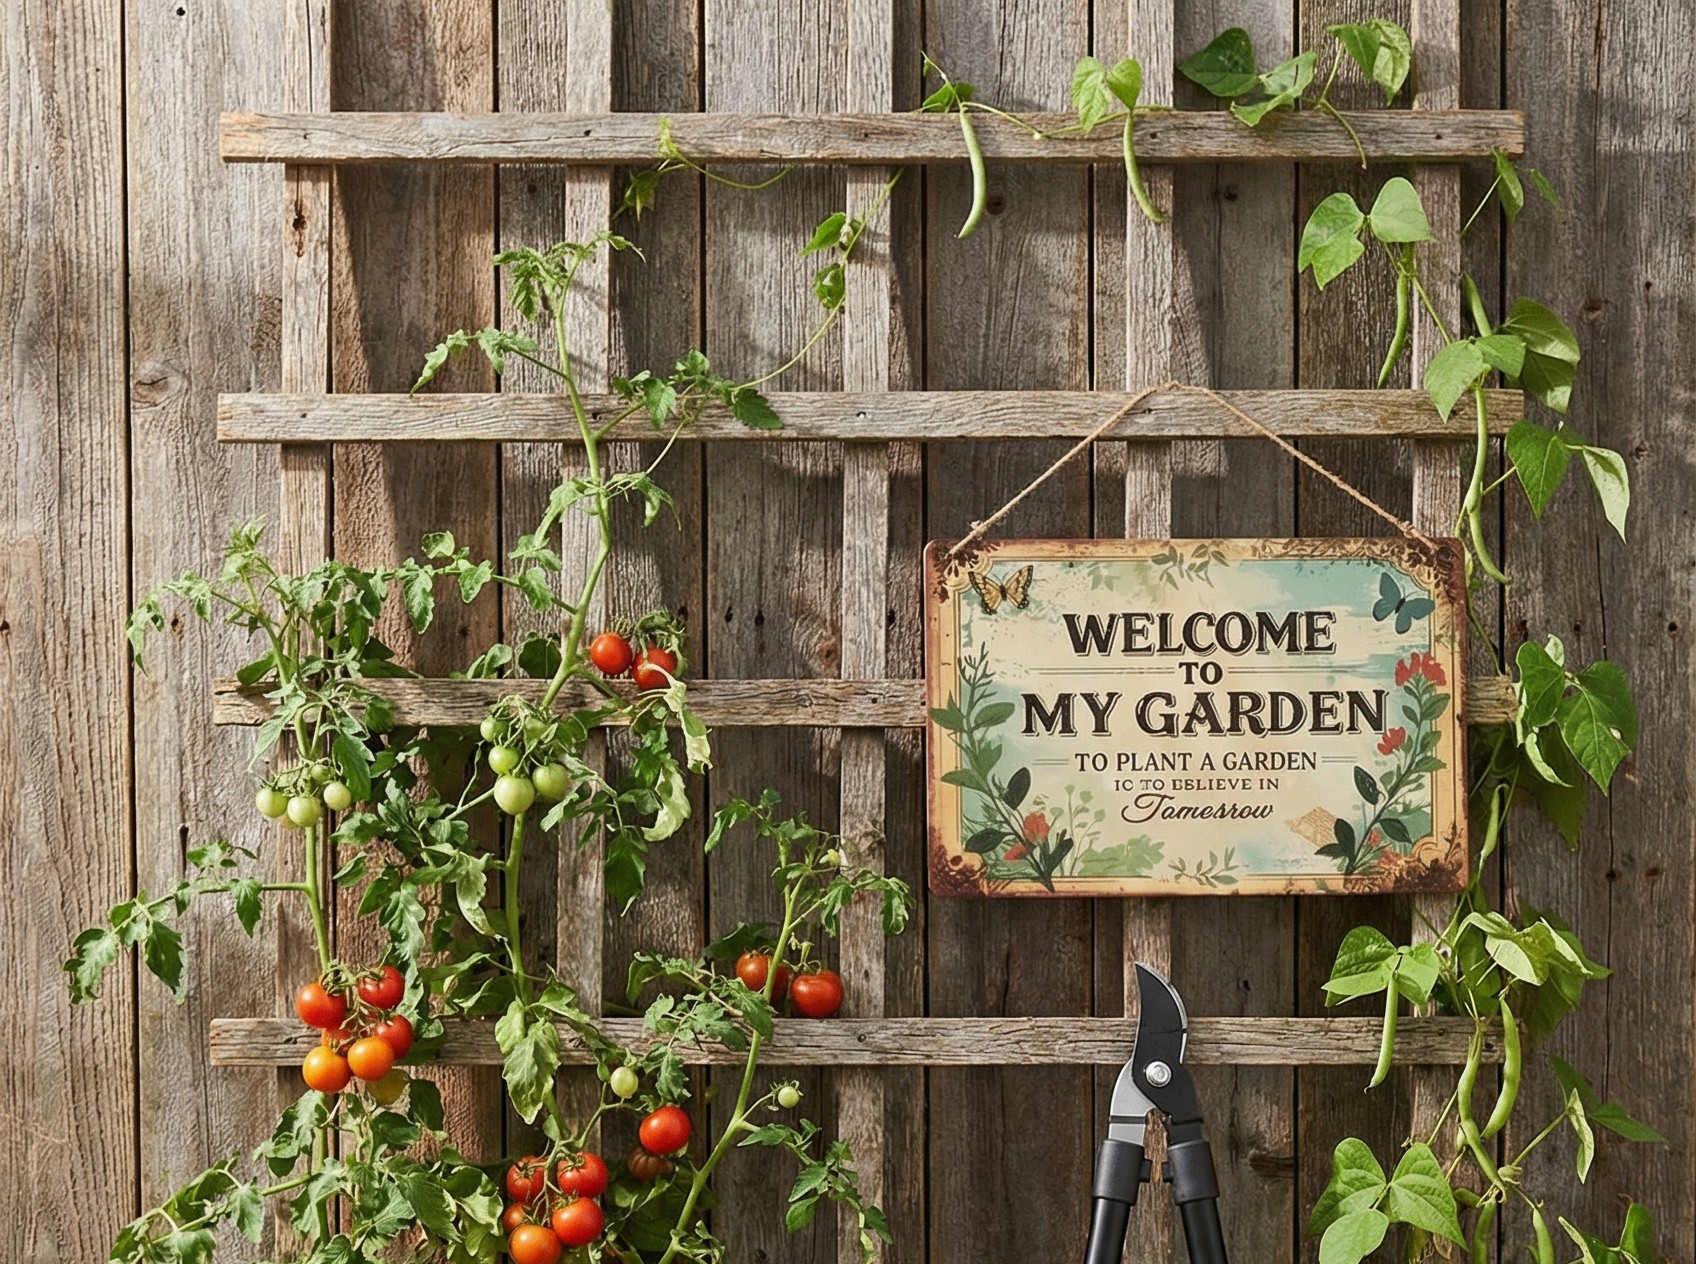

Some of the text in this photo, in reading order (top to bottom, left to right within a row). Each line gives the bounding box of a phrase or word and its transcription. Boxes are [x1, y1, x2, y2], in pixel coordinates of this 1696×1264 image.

[1062, 611, 1336, 657] WELCOME
[1178, 661, 1223, 685] TO
[1020, 690, 1389, 738] MY GARDEN
[1075, 751, 1317, 772] TO PLANT A GARDEN
[1140, 779, 1165, 791] TO
[1259, 778, 1279, 790] IN
